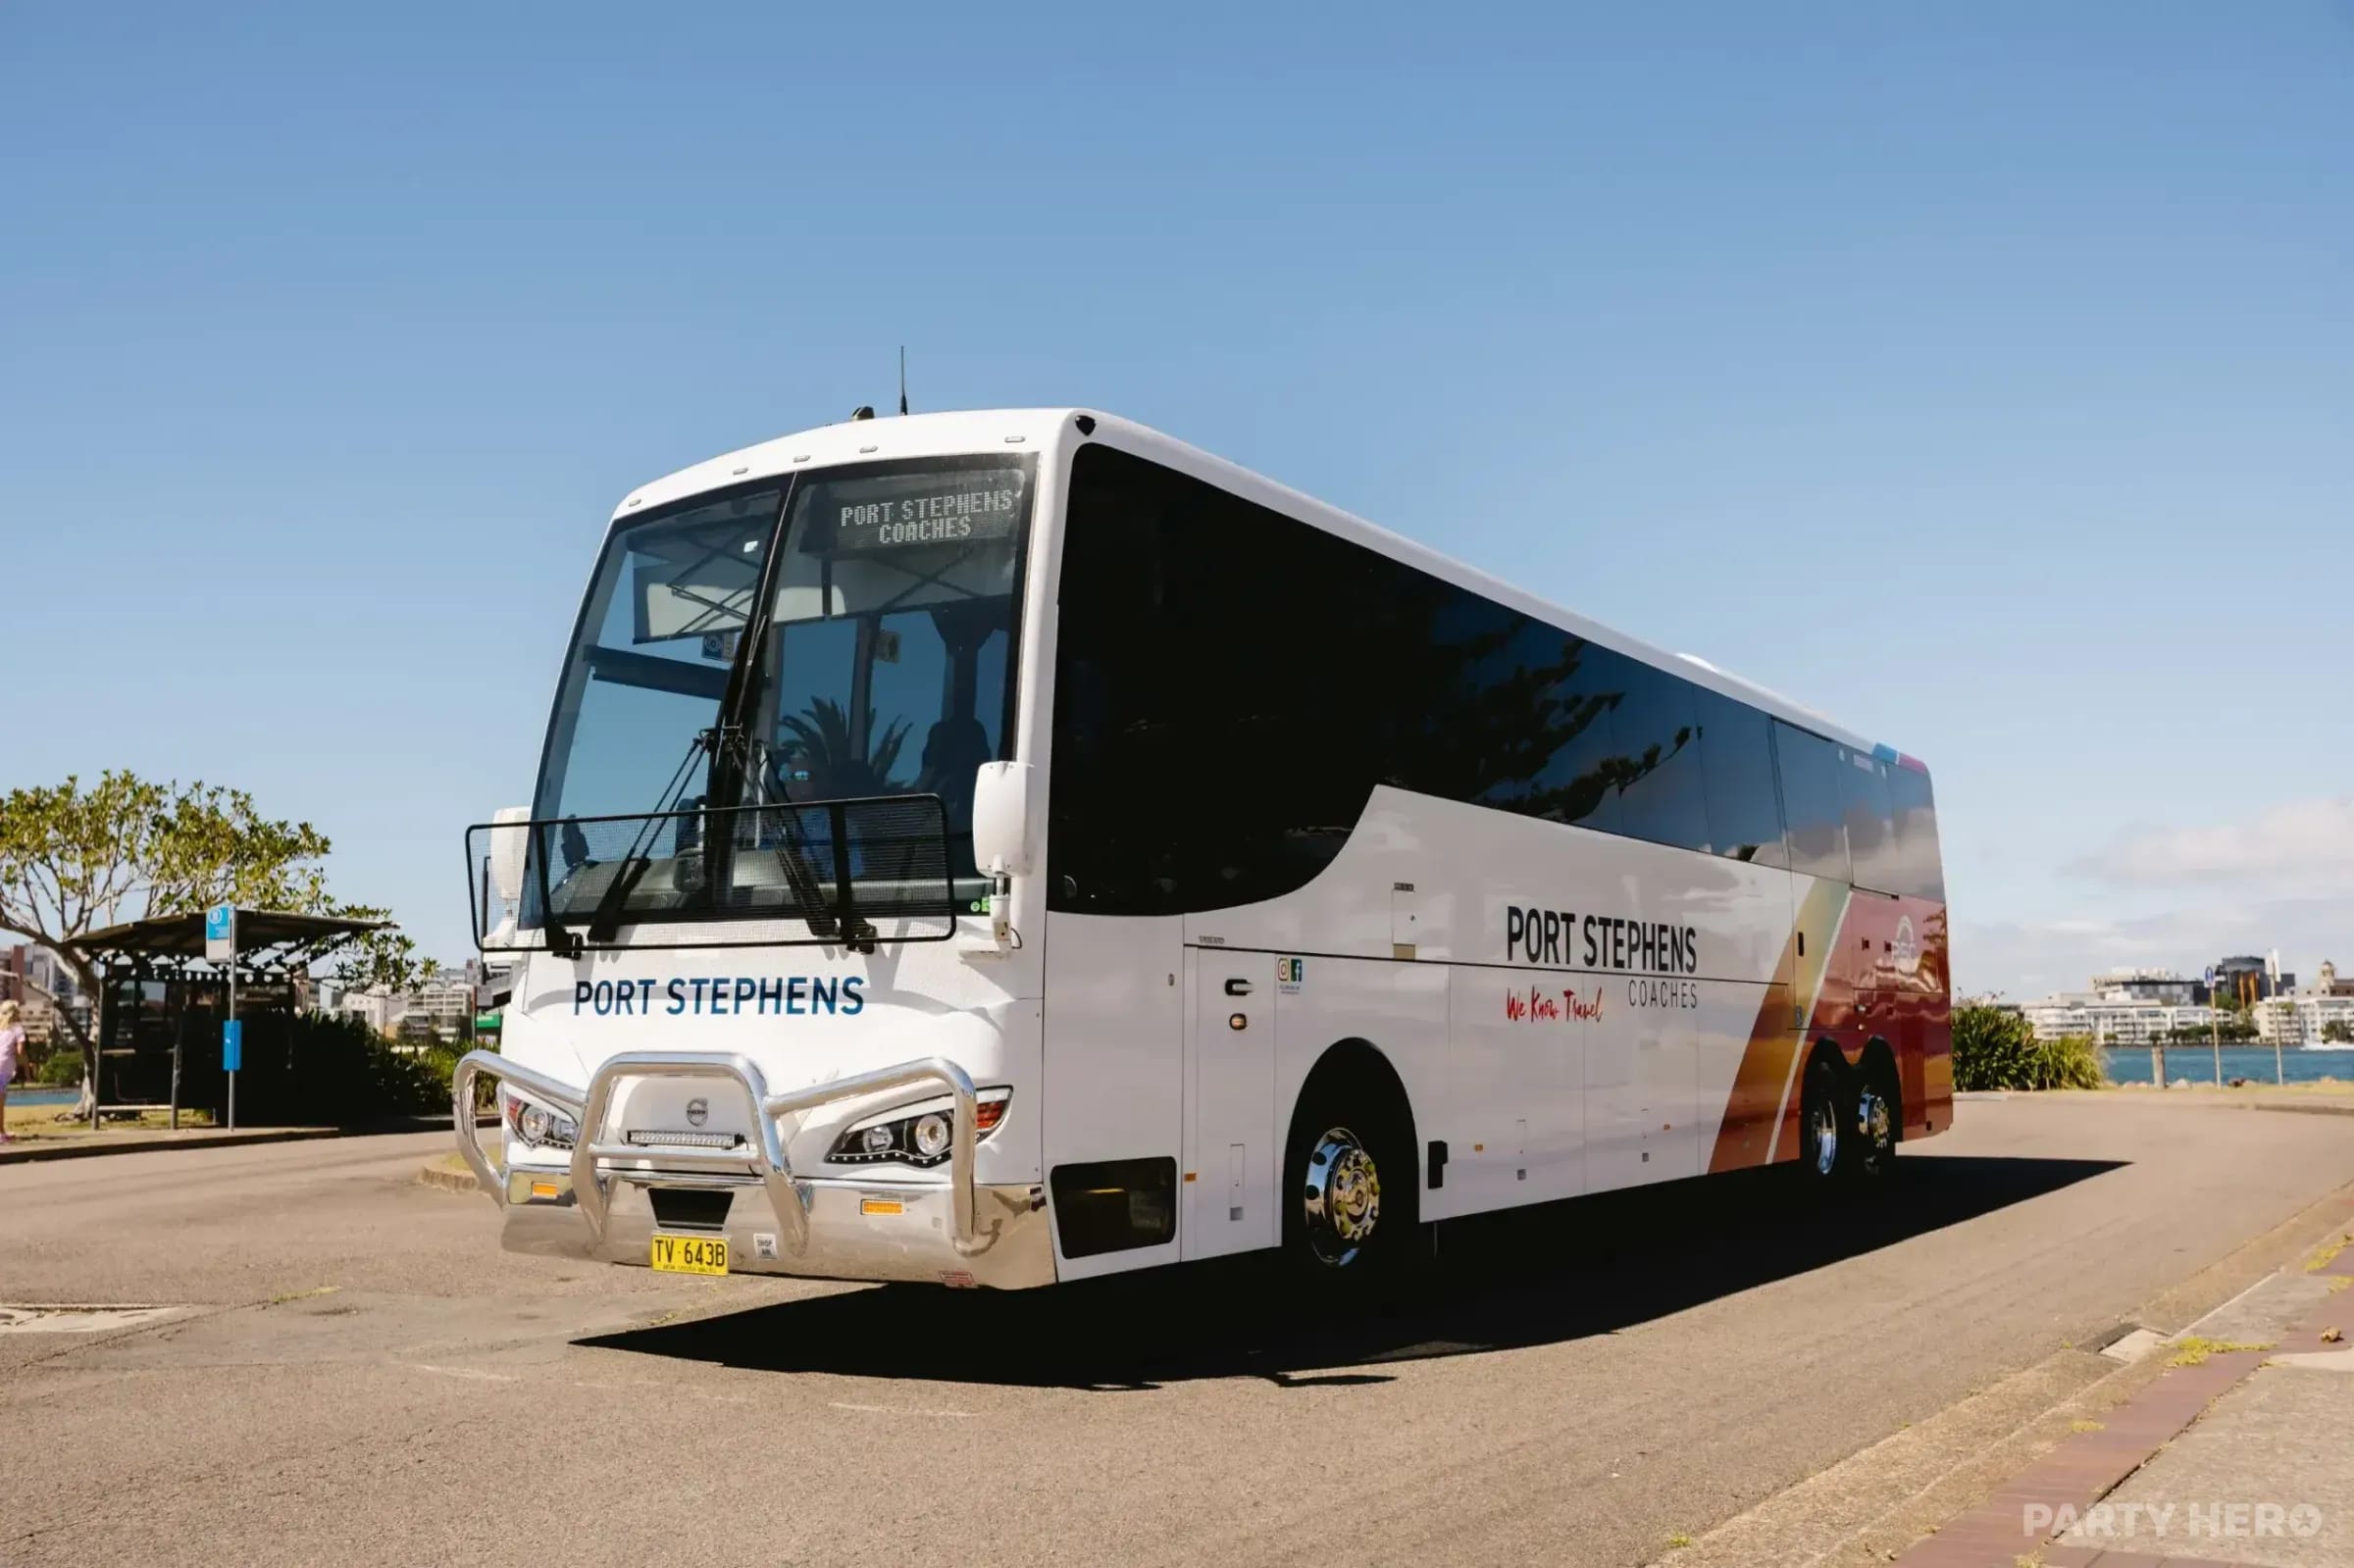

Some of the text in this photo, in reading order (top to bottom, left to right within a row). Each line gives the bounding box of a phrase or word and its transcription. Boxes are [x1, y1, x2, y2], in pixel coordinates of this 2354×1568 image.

[841, 489, 1013, 527] PORT STEPHENS
[879, 516, 971, 543] COACHES
[1507, 905, 1697, 974] PORT STEPHENS
[574, 976, 865, 1016] PORT STEPHENS
[1507, 986, 1604, 1023] We Know Travel
[1628, 980, 1698, 1009] COACHES
[655, 1239, 726, 1267] TV 643B
